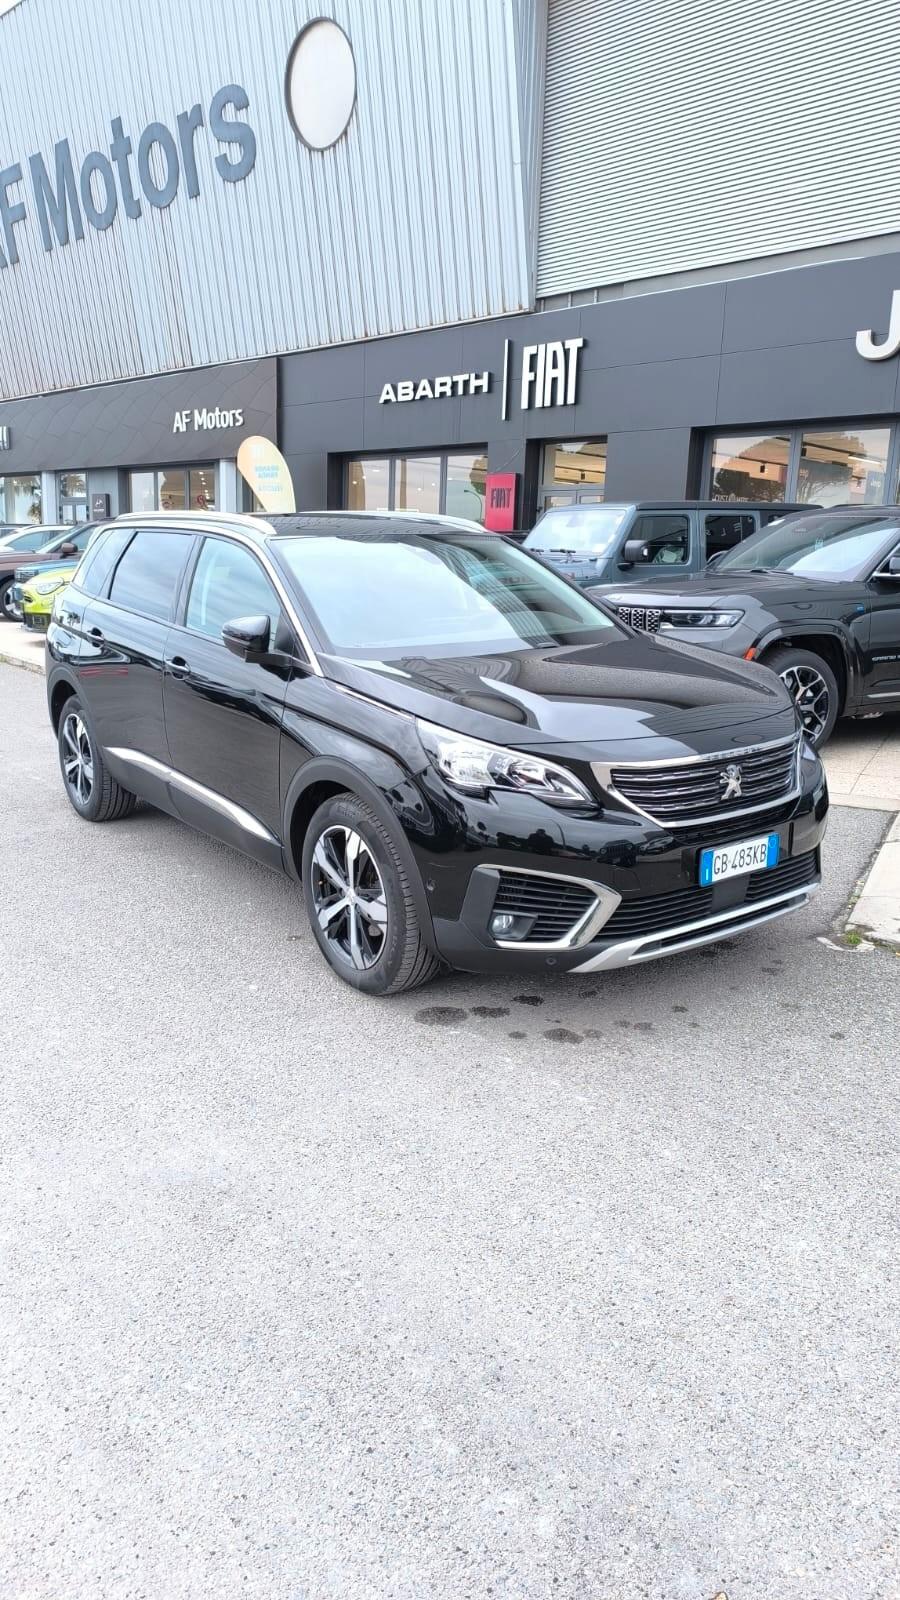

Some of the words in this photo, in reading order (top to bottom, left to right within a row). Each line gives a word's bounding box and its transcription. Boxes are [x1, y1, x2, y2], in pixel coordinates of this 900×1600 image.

[0, 162, 27, 268] F
[29, 83, 257, 252] Motors
[379, 371, 490, 404] ABARTH
[521, 337, 584, 410] FIAT
[173, 410, 192, 433] AF
[194, 407, 244, 431] Motors
[490, 487, 512, 509] FIAT
